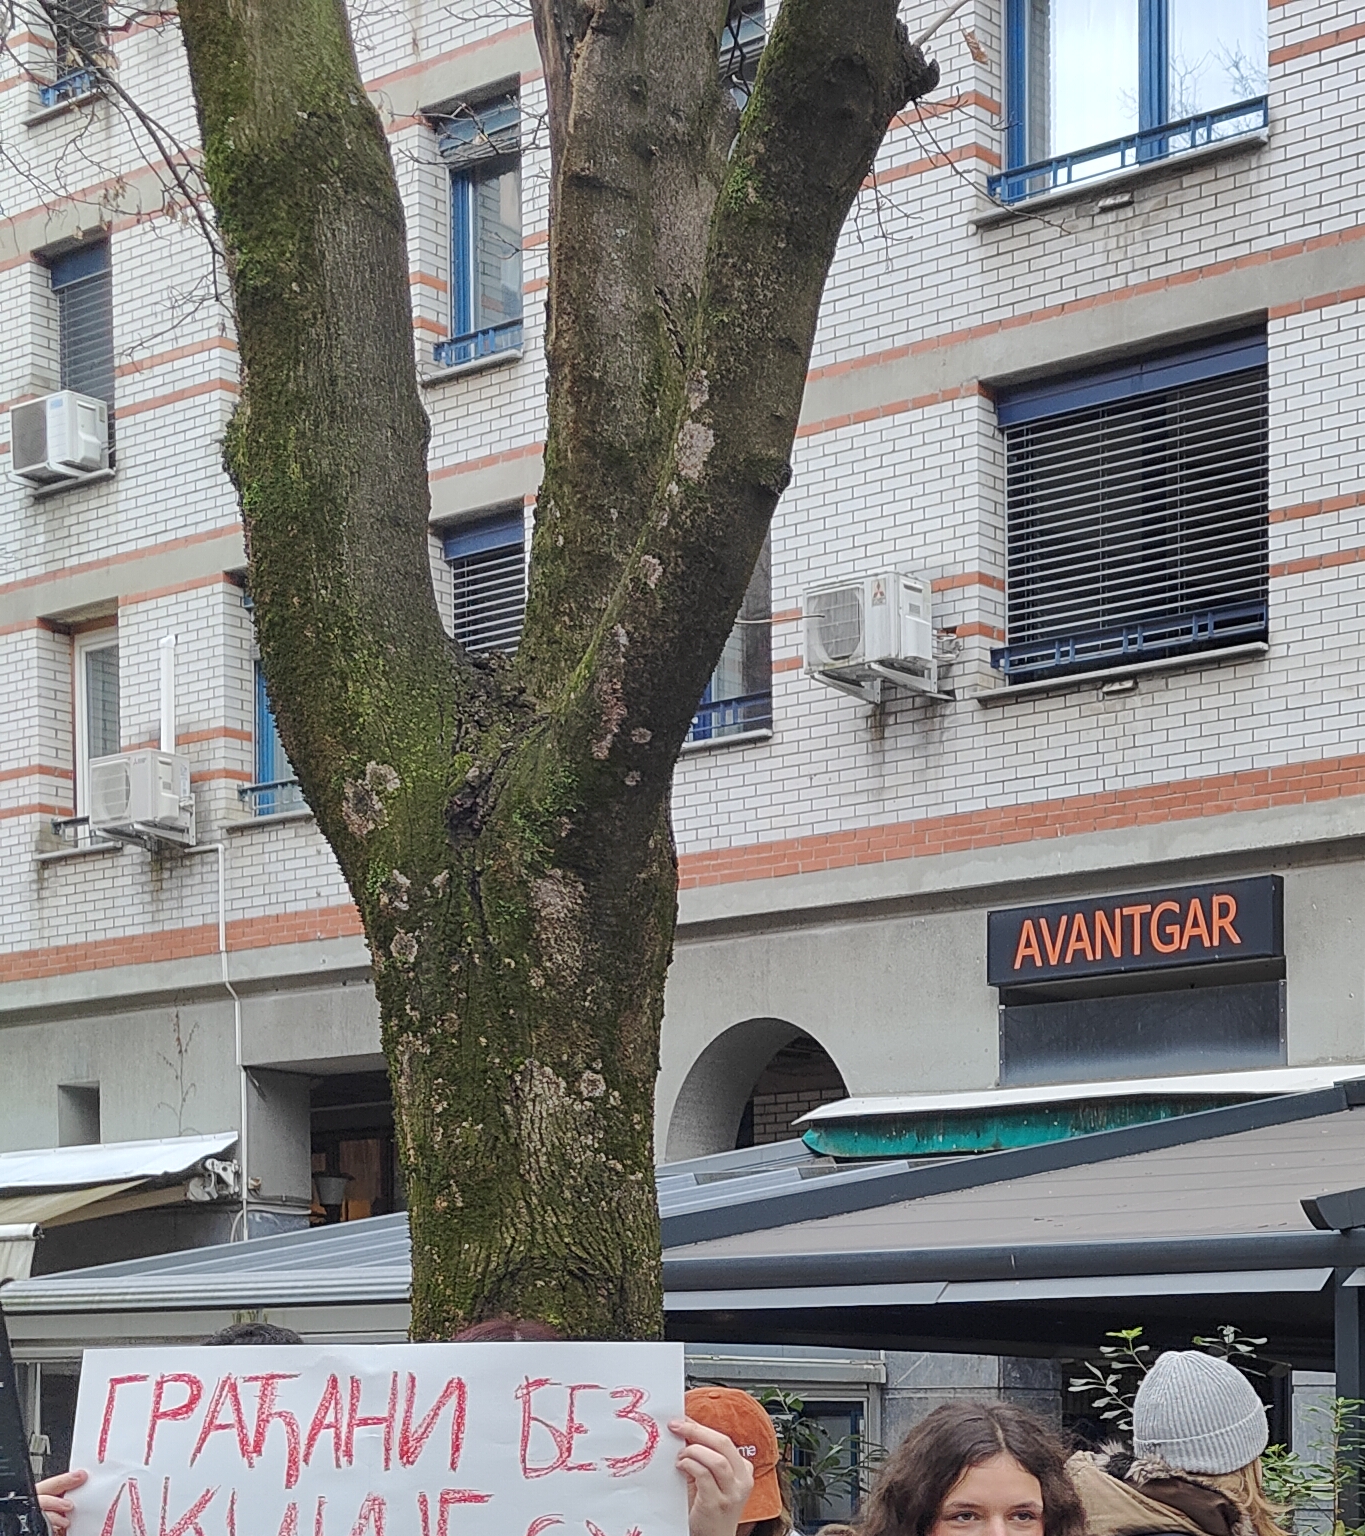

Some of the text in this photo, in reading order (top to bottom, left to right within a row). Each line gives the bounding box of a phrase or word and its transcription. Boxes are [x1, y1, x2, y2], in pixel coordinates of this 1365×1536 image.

[1013, 893, 1242, 970] AVANTGAR
[97, 1371, 660, 1490] ГРАЂАНИ БЕЗ
